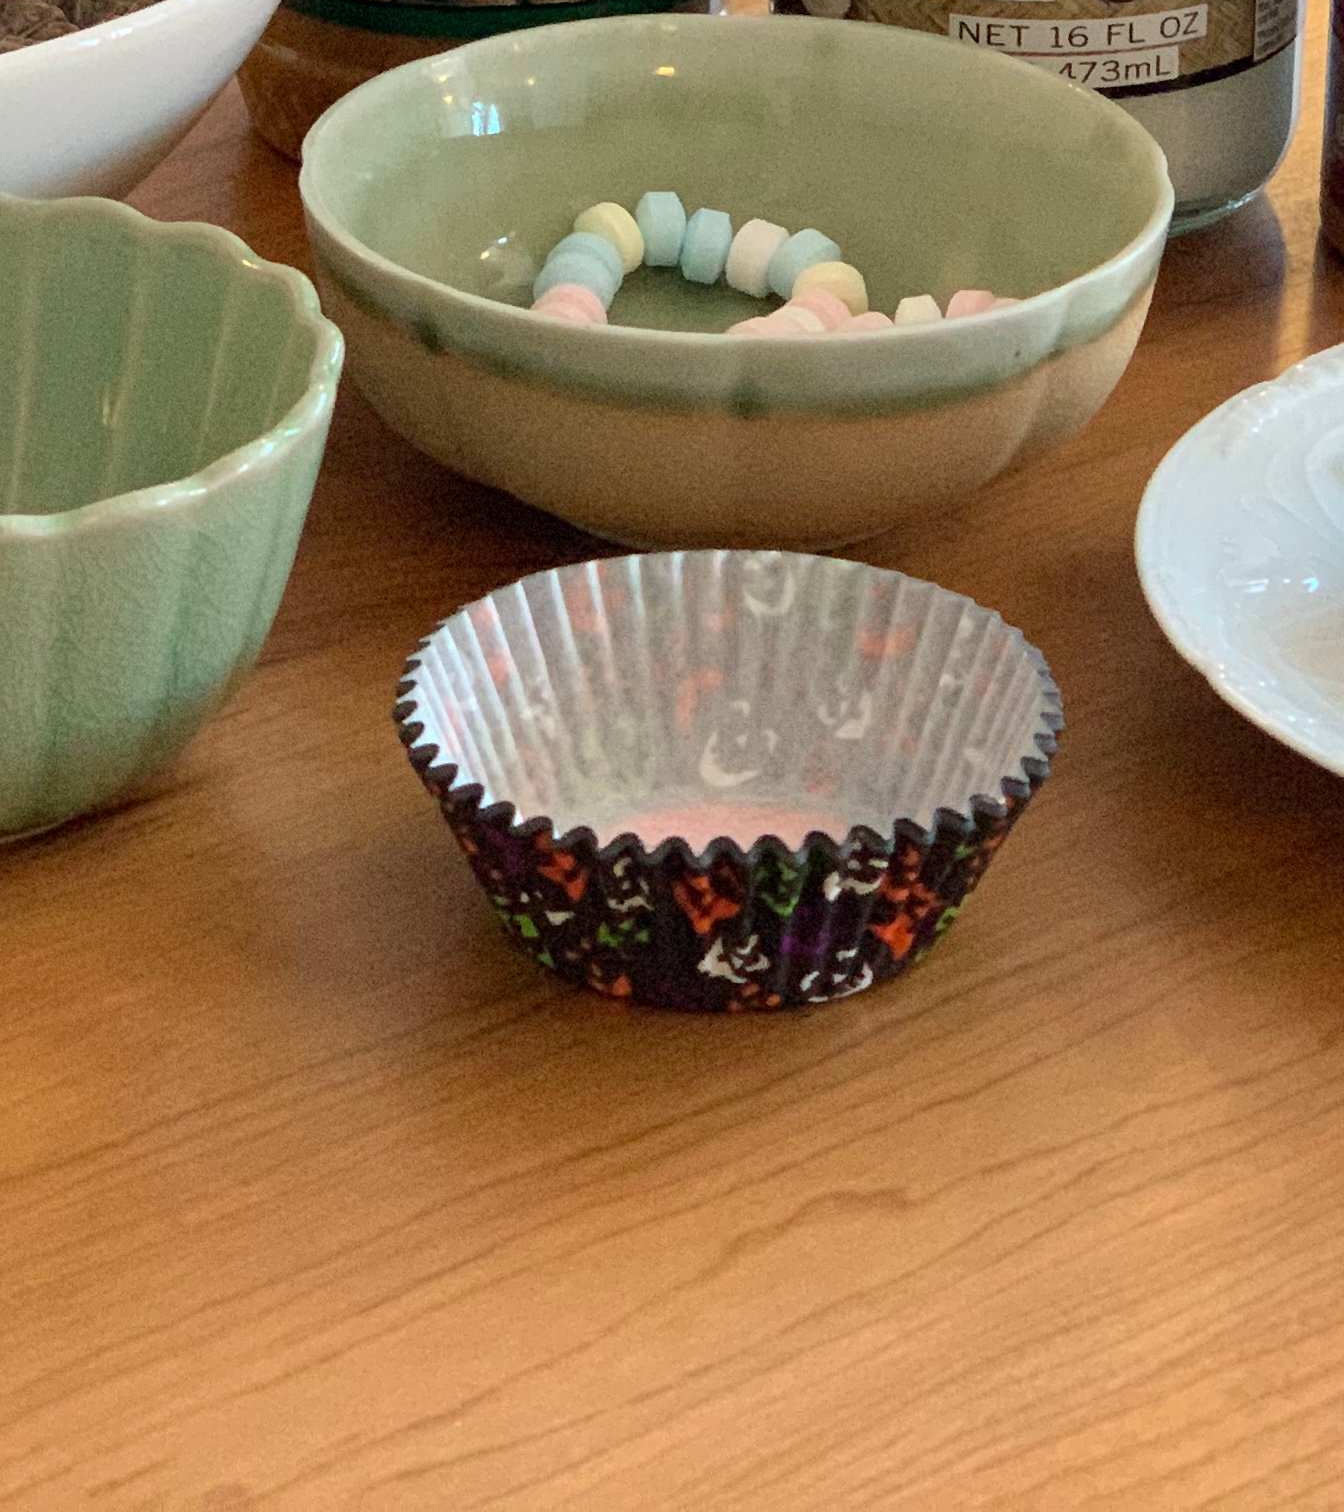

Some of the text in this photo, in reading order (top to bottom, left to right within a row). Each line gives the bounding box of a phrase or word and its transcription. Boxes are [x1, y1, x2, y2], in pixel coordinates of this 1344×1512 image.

[958, 11, 1199, 48] NET 16 FL OZ
